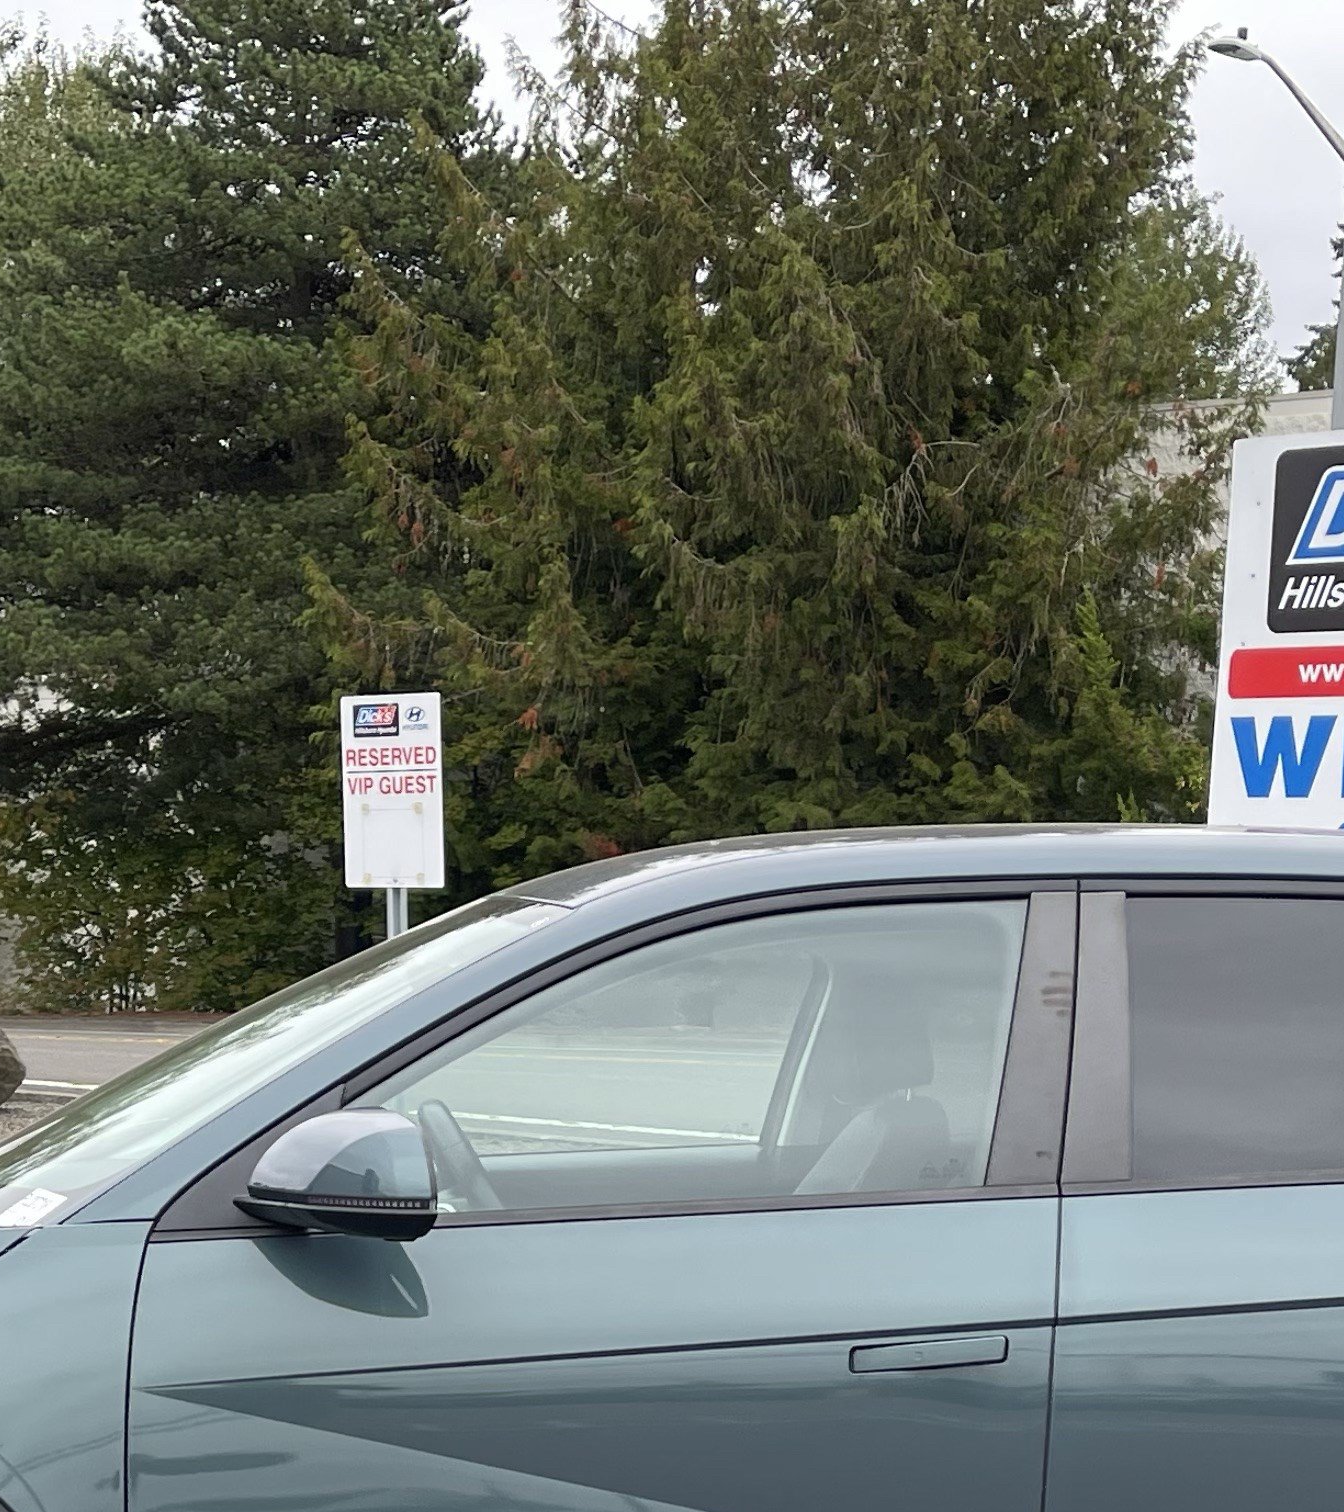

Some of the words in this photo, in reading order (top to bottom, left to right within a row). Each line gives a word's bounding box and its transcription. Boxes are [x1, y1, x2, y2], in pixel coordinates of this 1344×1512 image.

[346, 746, 436, 767] RESERVED
[348, 776, 373, 795] VIP
[379, 775, 437, 795] GUEST
